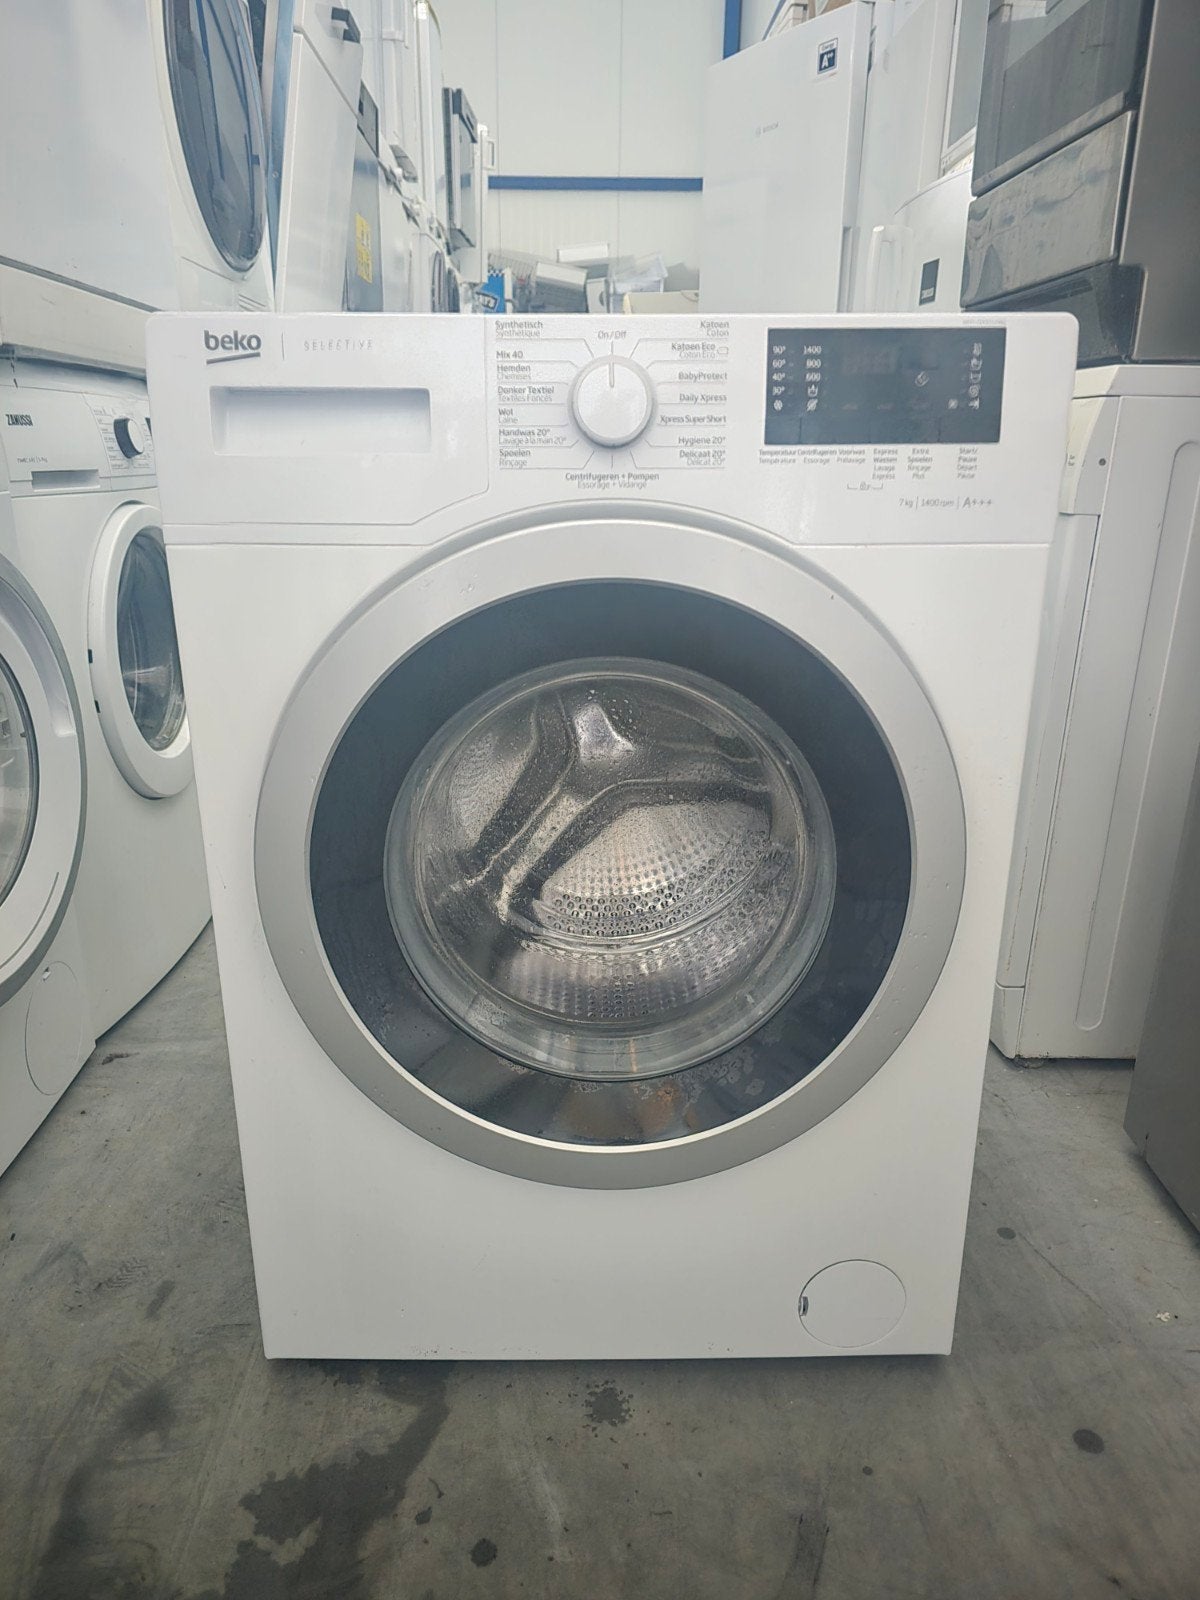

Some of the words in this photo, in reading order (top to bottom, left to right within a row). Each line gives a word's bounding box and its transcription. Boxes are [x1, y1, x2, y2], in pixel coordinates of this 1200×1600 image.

[495, 320, 543, 331] Synthetisch
[701, 321, 729, 329] Katoen
[706, 329, 729, 337] Coton
[204, 330, 262, 351] beko
[304, 339, 373, 351] SELECTIVE
[672, 343, 700, 351] Katoen
[803, 345, 822, 355] 1400
[496, 351, 511, 359] Mix
[512, 351, 523, 359] 40
[497, 364, 531, 372] Hemden
[678, 372, 728, 381] BabyProtect
[497, 386, 526, 394] Donker
[528, 386, 554, 394] Textiel
[679, 393, 698, 403] Daily
[700, 394, 727, 403] Xpress
[499, 408, 513, 416] Wol
[5, 414, 33, 427] ZANUSSI
[660, 415, 684, 424] Xpress
[685, 415, 705, 424] Super
[706, 415, 727, 423] Short
[499, 429, 535, 437] Handwas
[499, 437, 524, 446] Lavage
[678, 436, 711, 445] Hygiene
[500, 449, 531, 458] Spoelen
[679, 450, 710, 458] Delicaat
[565, 473, 620, 482] Centrifugeren
[627, 473, 660, 481] Pompen
